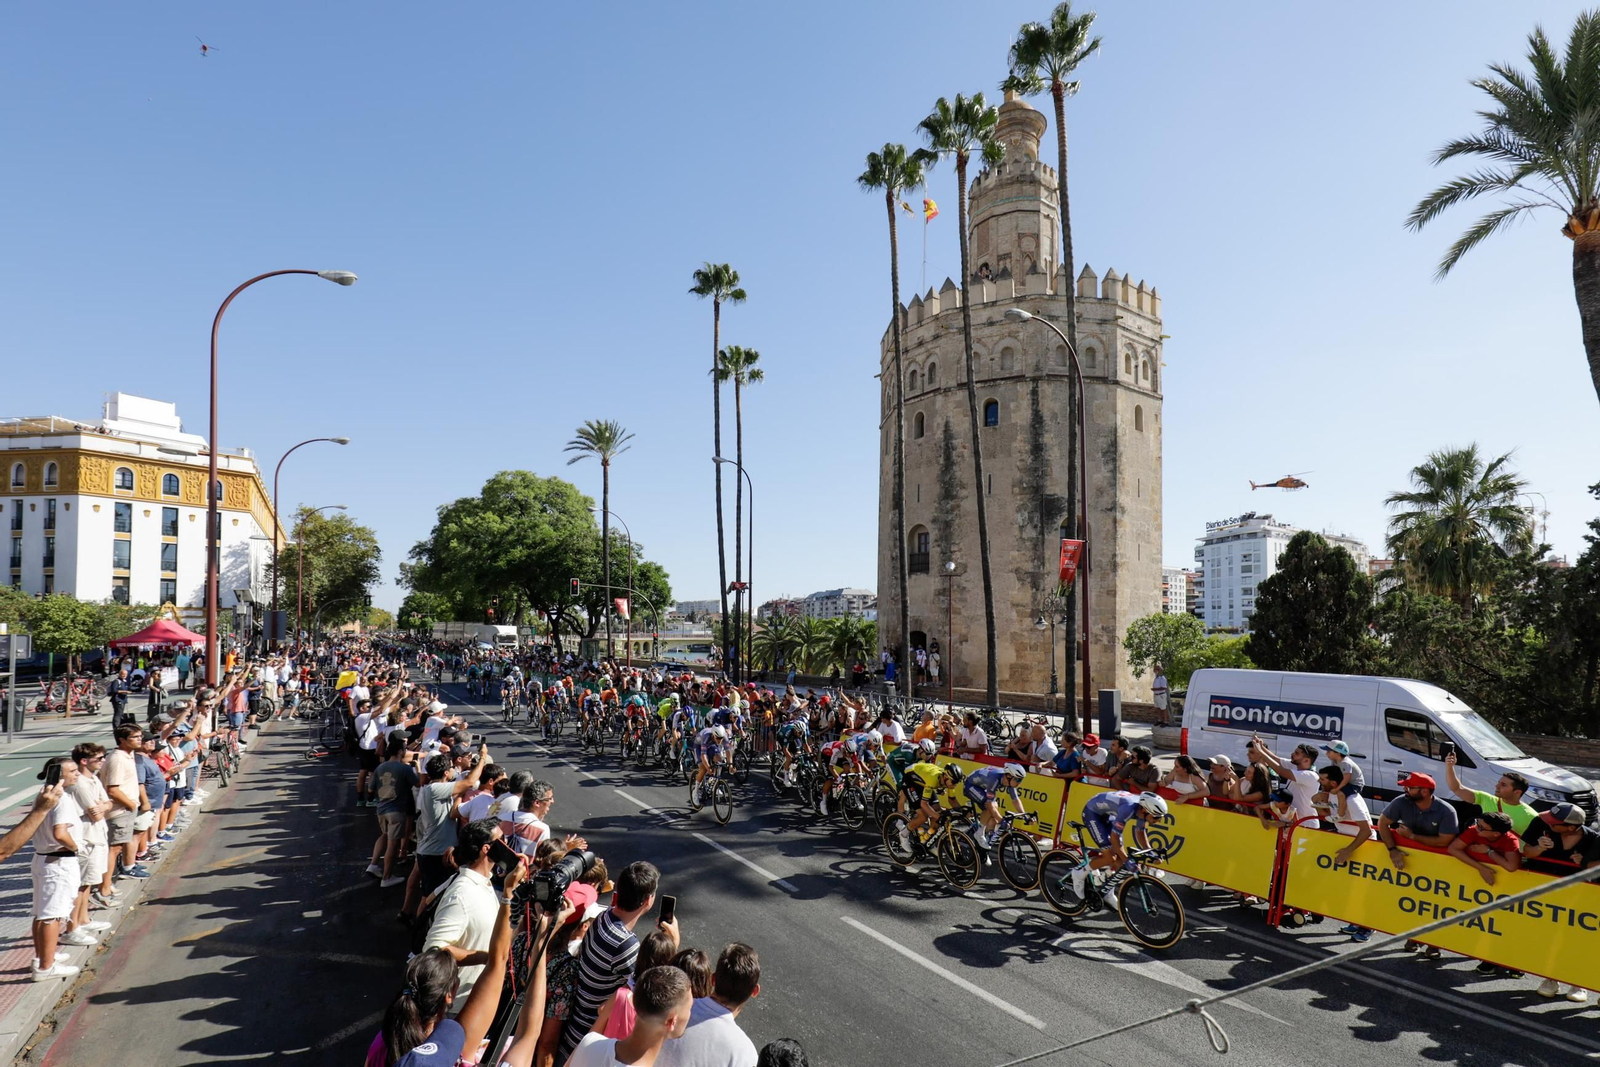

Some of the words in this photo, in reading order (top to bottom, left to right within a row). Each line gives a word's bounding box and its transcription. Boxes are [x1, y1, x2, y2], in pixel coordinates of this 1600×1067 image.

[1206, 520, 1221, 529] Diario
[1210, 704, 1341, 732] montavon
[1101, 868, 1129, 894] CANYON
[1316, 854, 1451, 897] OPERADOR
[1458, 884, 1600, 932] LOGISTIC
